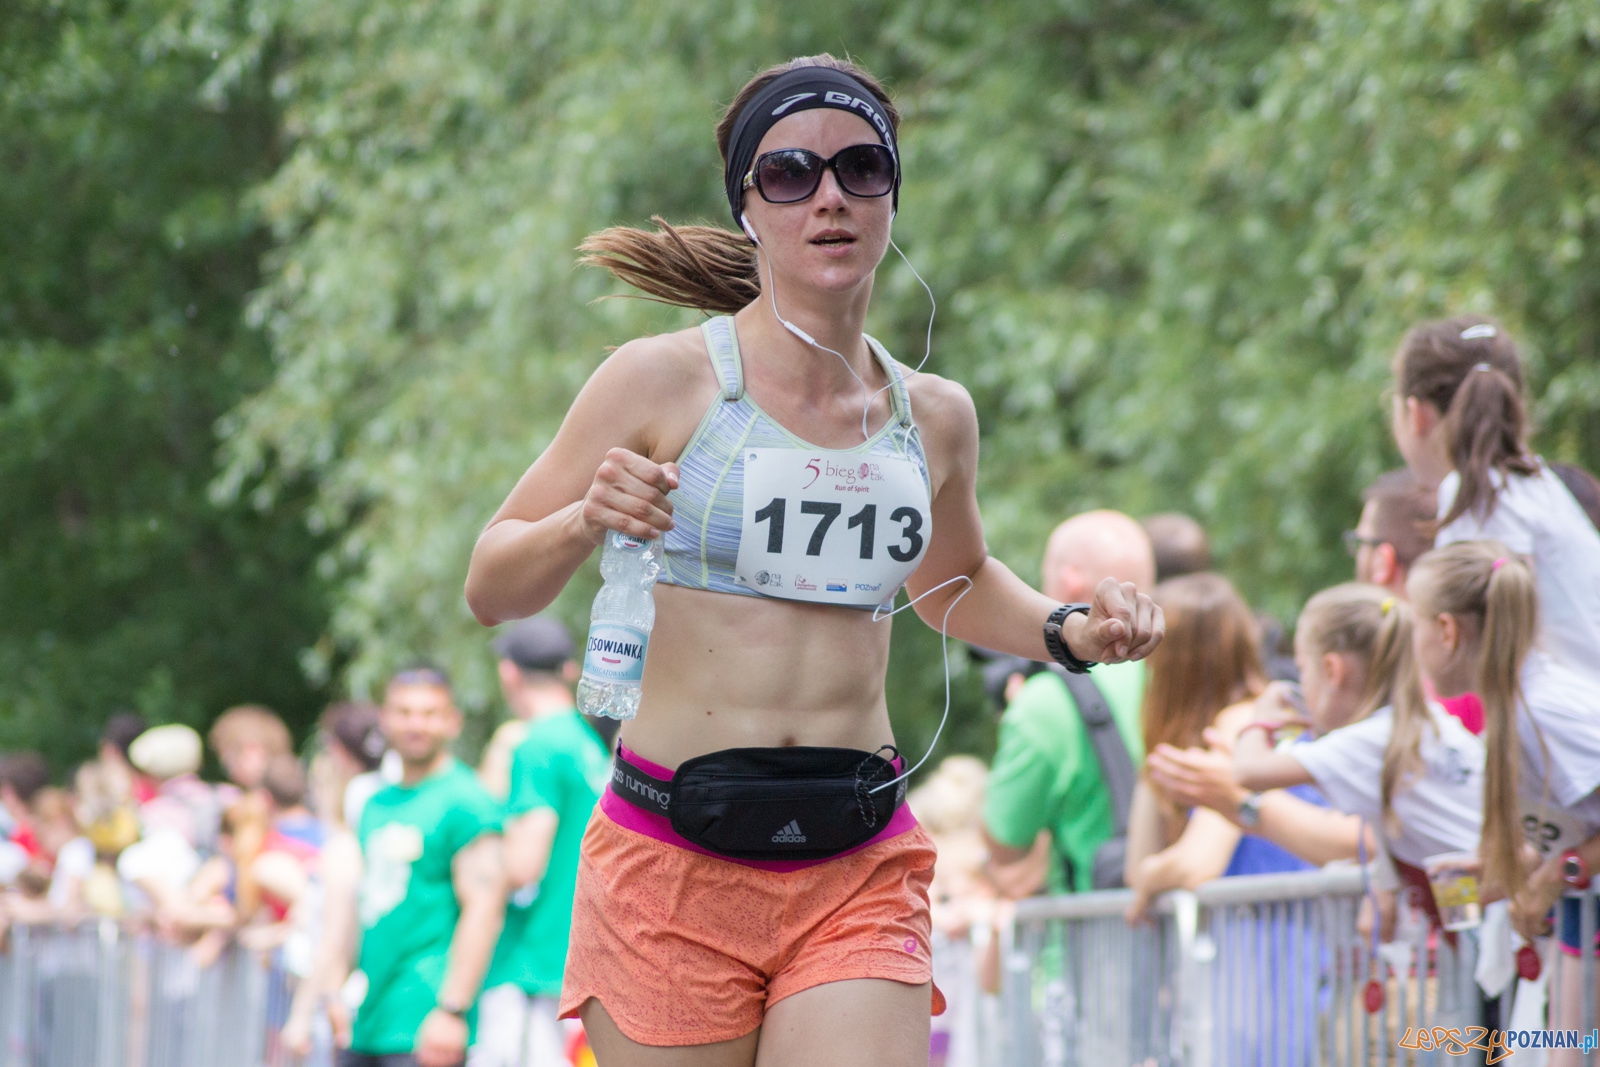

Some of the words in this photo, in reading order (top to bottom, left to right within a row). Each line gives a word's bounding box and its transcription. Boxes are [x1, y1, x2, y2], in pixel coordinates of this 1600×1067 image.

[824, 91, 897, 164] BROO
[802, 458, 821, 490] 5
[825, 460, 857, 485] bieg
[869, 463, 880, 471] na
[870, 471, 886, 482] tak
[854, 485, 870, 494] Spirit
[754, 497, 924, 562] 1713
[625, 774, 671, 810] running
[771, 834, 807, 843] adidas
